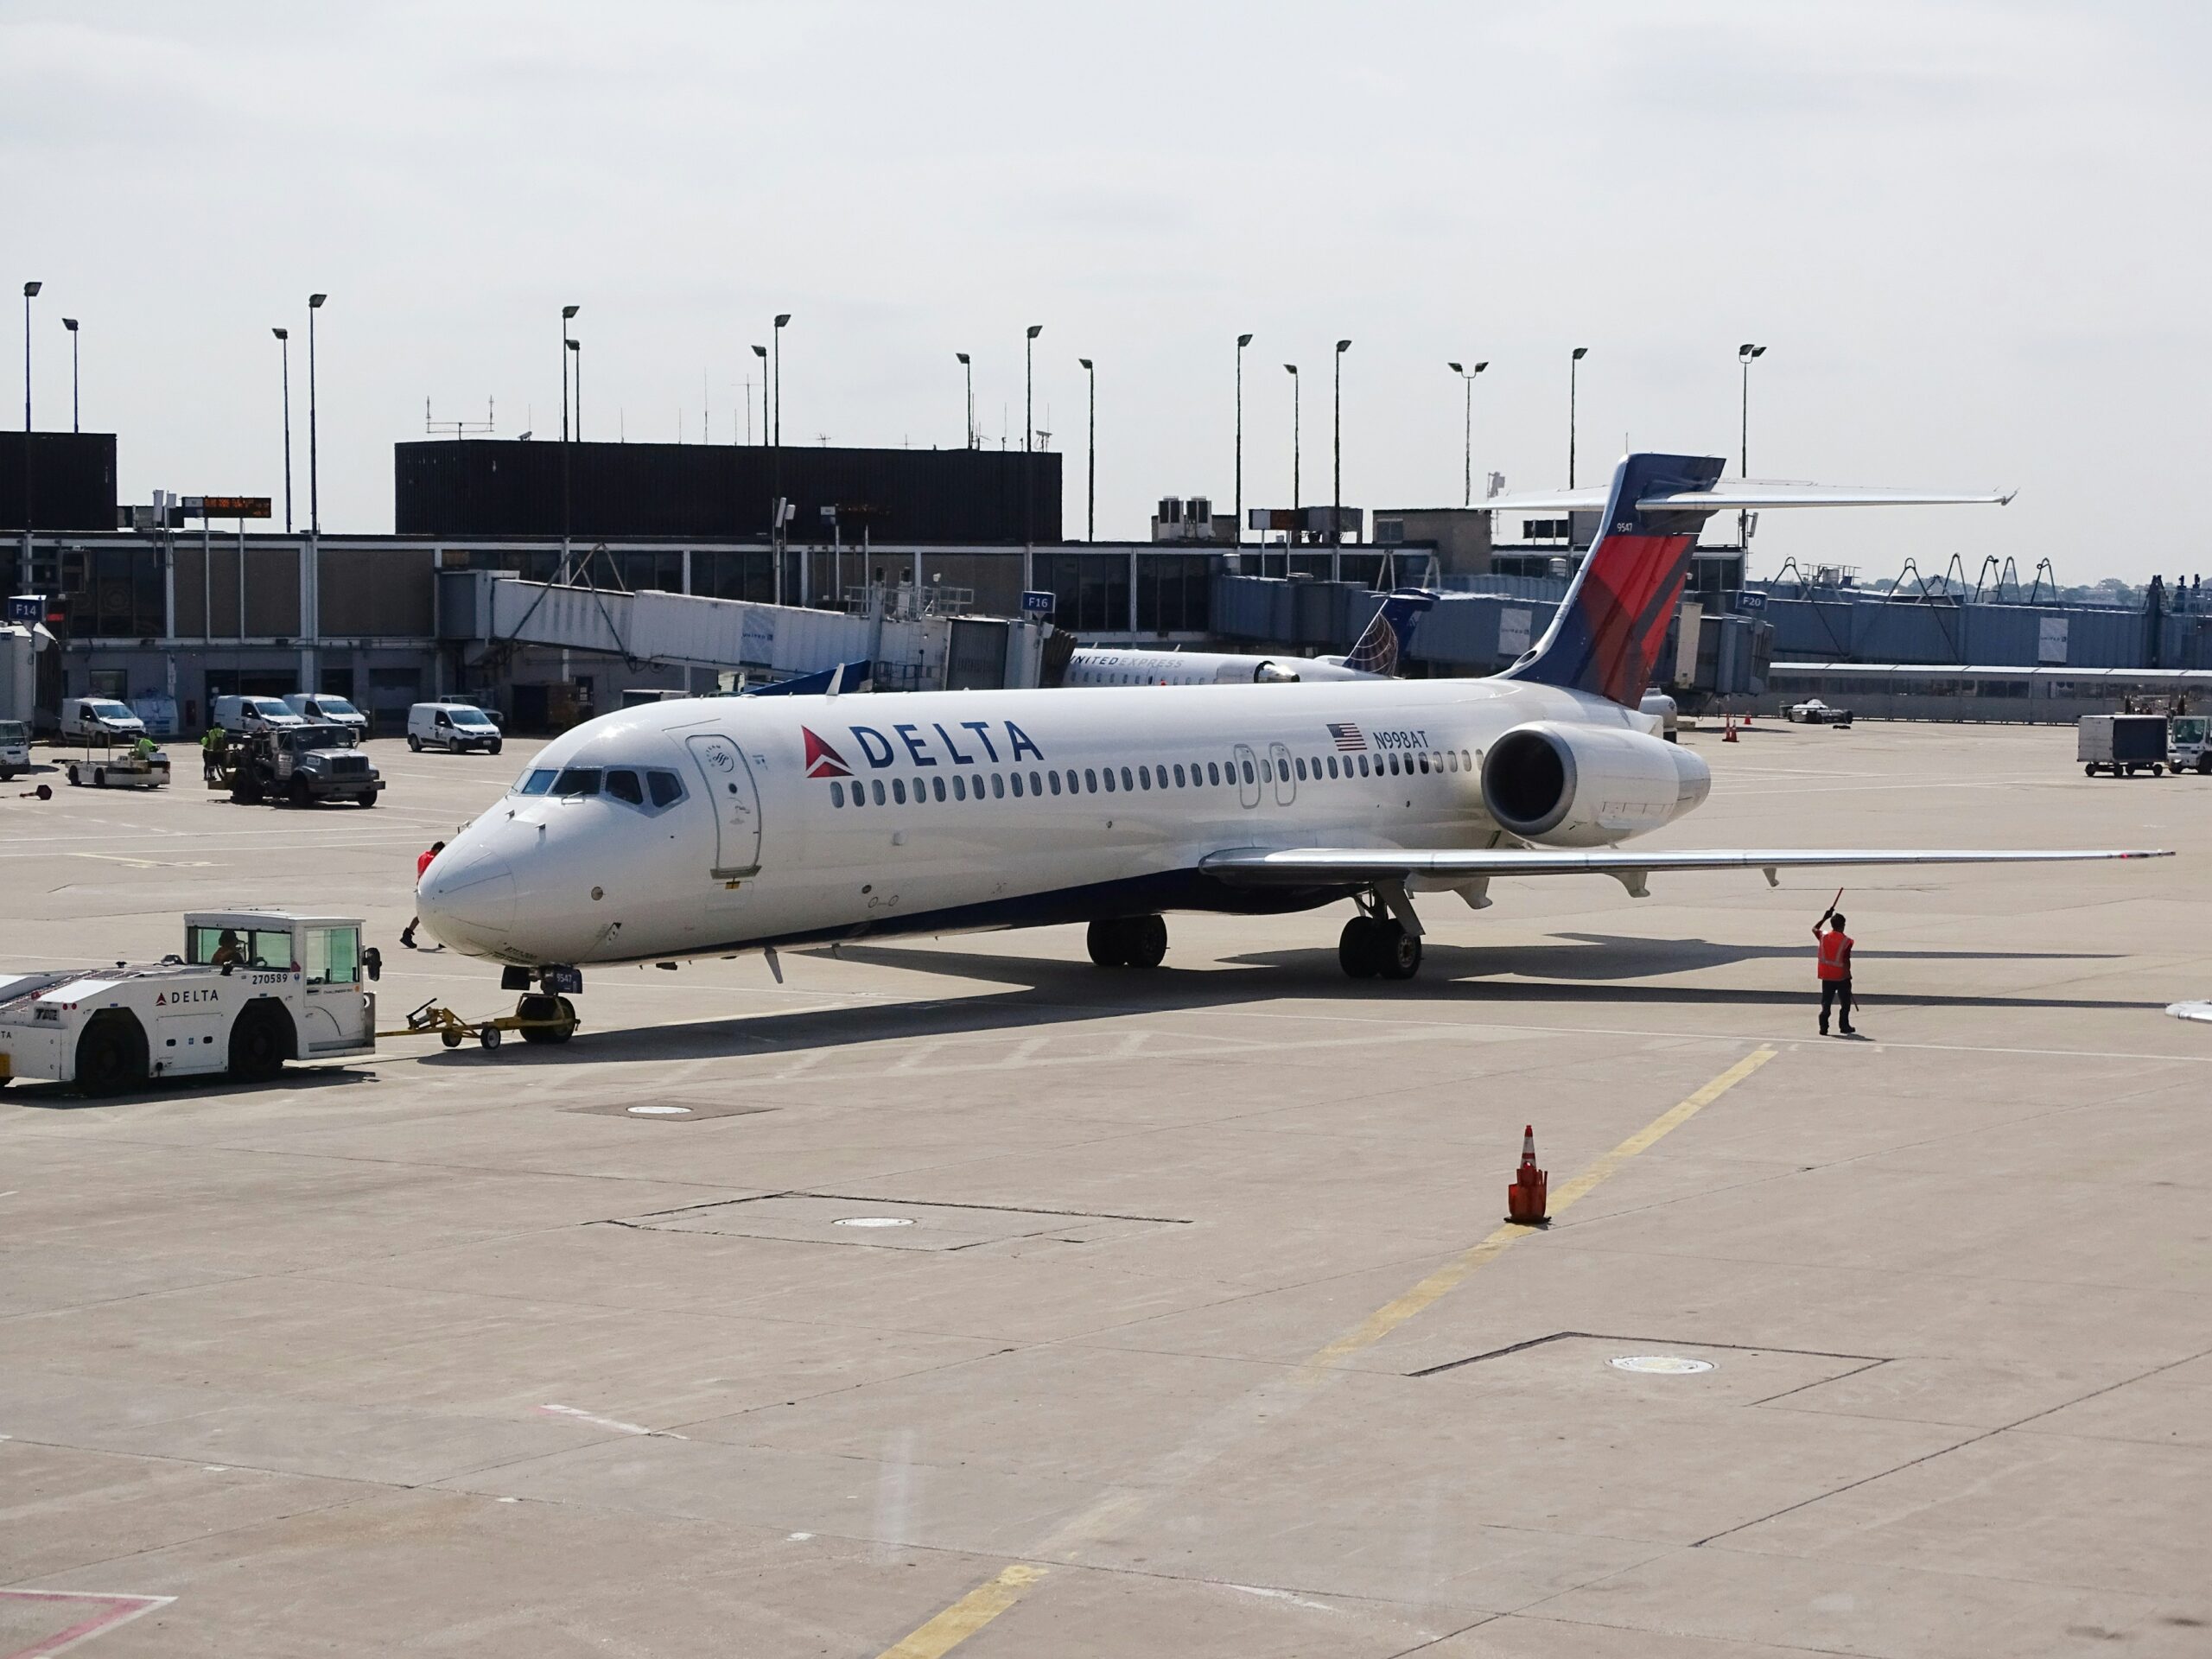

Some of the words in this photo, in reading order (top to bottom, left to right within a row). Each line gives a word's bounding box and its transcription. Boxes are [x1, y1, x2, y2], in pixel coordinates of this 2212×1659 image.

[1028, 597, 1048, 608] F16
[1743, 596, 1761, 607] F20
[16, 604, 36, 616] F14
[849, 721, 1045, 769] DELTA
[1372, 730, 1428, 750] N998AT
[251, 973, 288, 985] 270589
[171, 989, 219, 1004] DELTA
